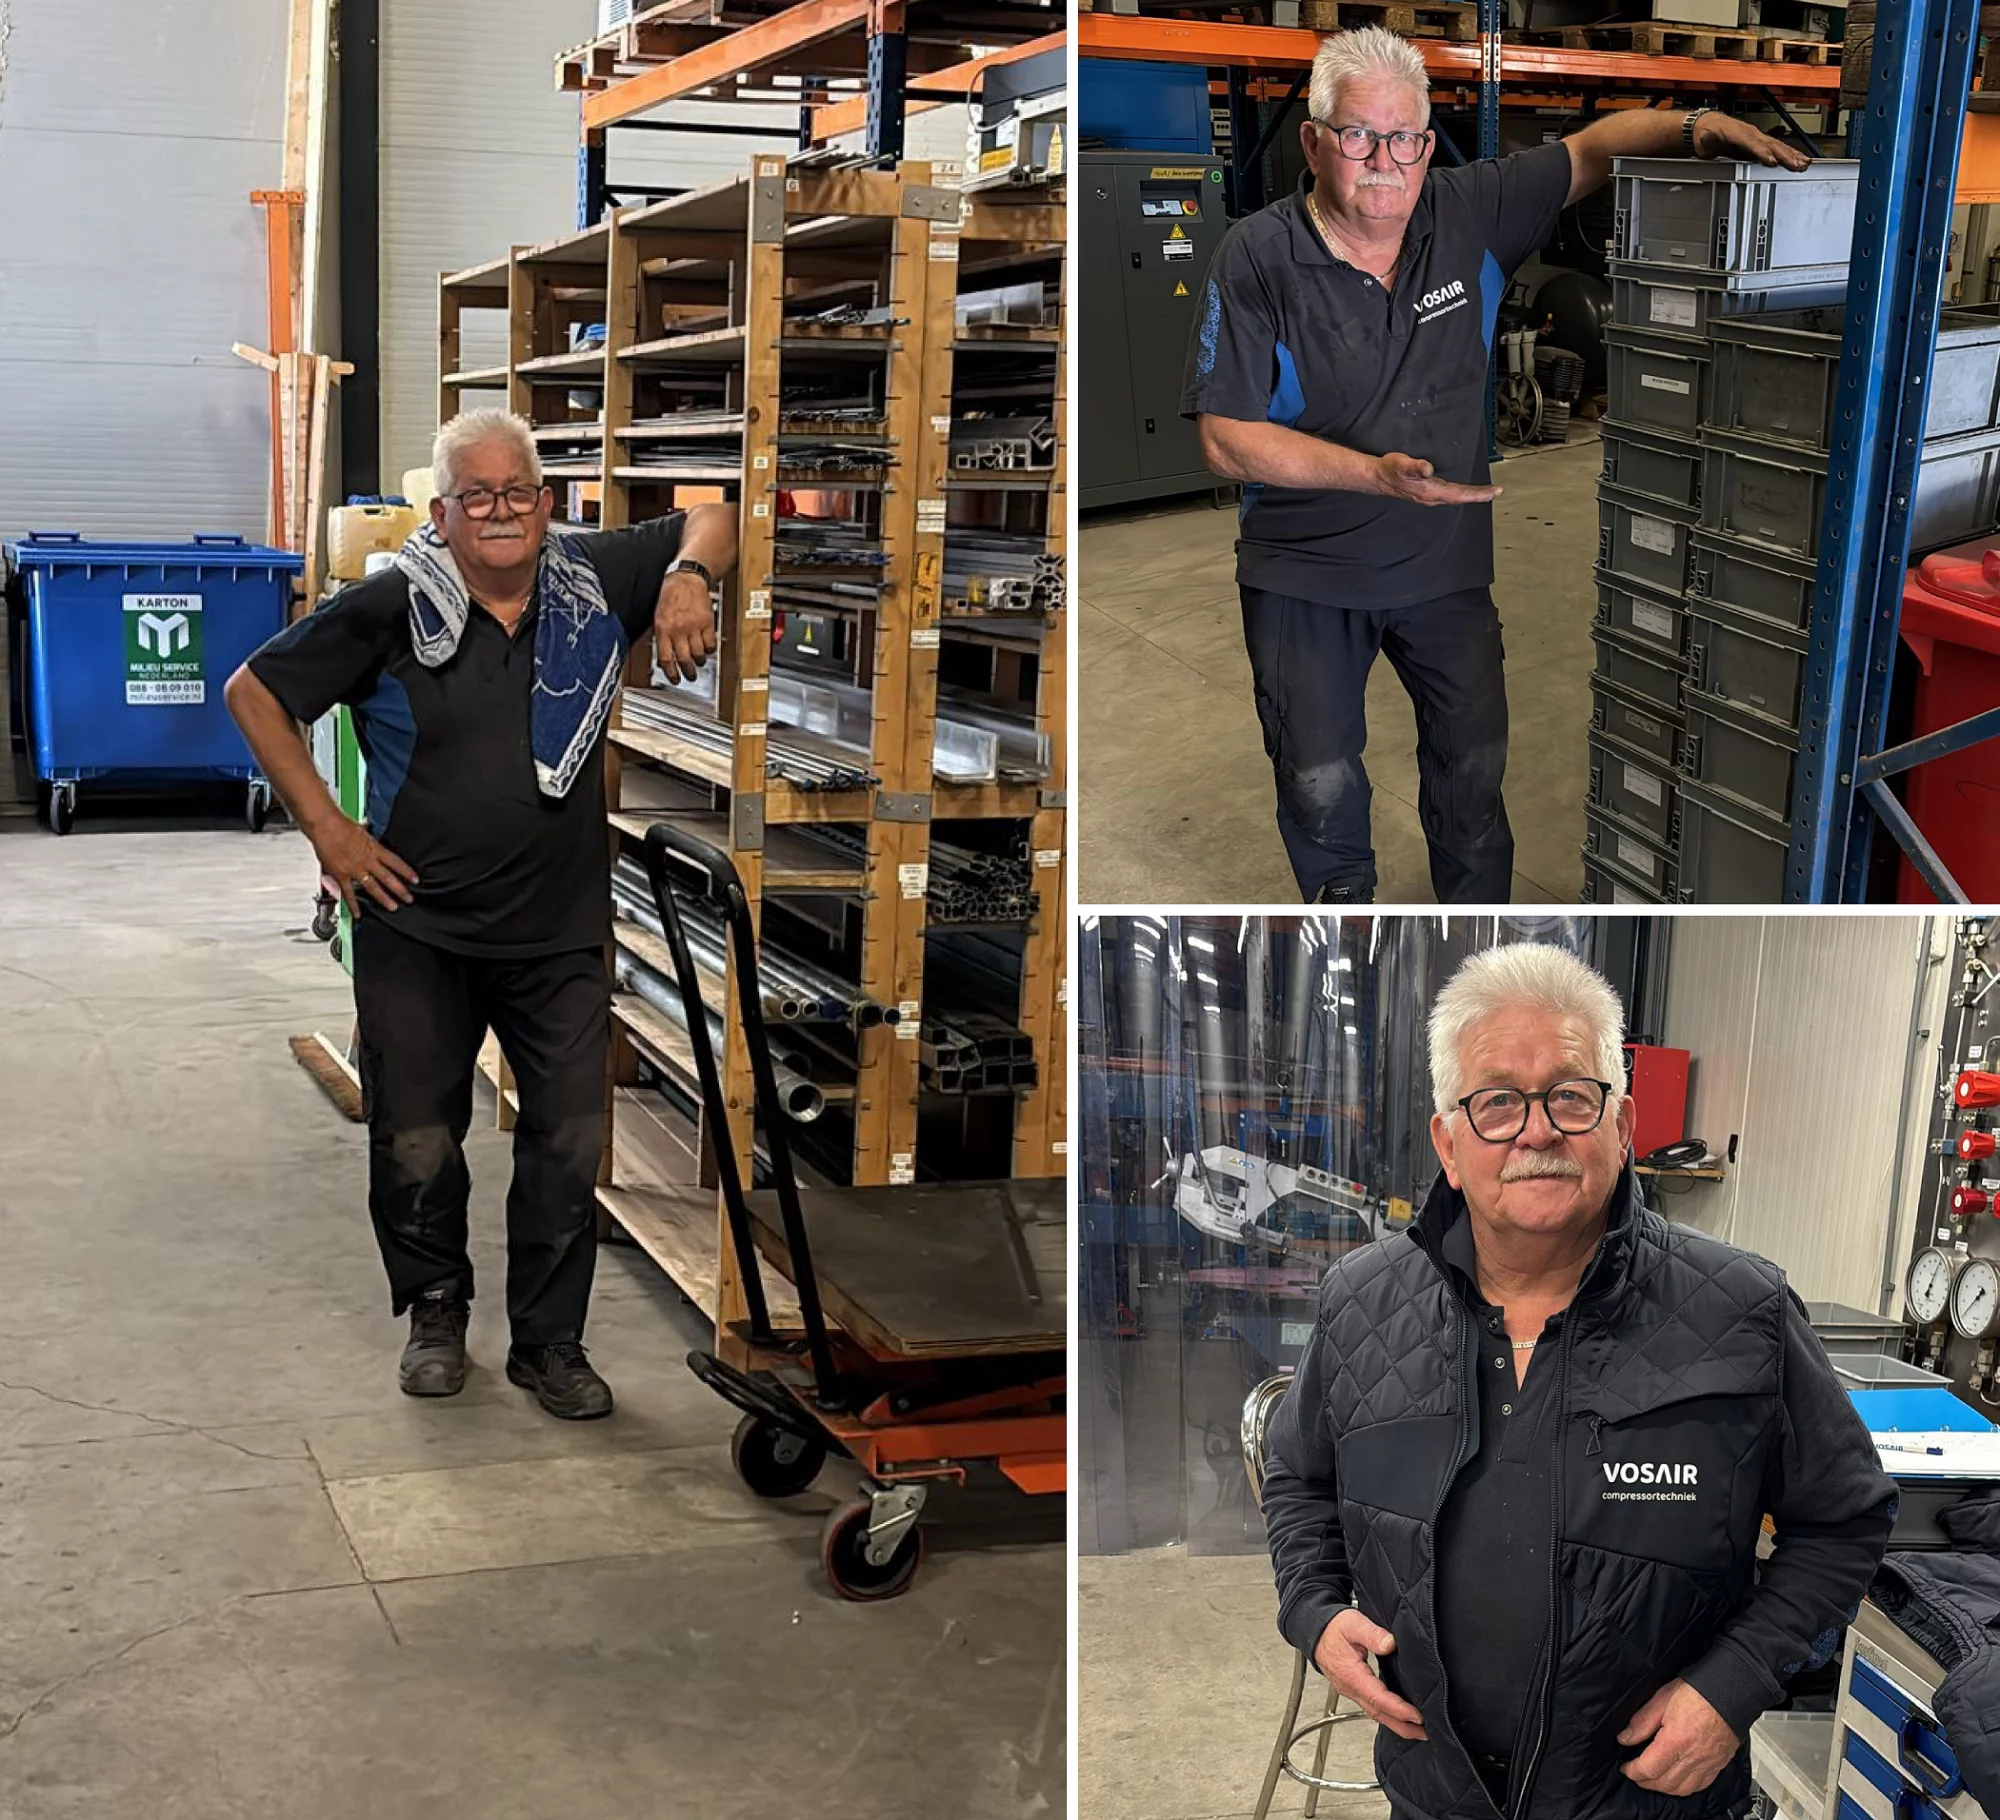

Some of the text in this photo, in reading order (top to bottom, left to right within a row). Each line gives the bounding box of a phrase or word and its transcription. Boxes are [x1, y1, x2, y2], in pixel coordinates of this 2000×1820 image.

[1413, 280, 1465, 313] VOSAIR
[1417, 298, 1468, 325] compressortechniek
[137, 598, 188, 608] KARTON
[162, 663, 199, 672] SERVICE
[1602, 1462, 1698, 1485] VOSAIR
[1602, 1491, 1697, 1502] compressortechniek
